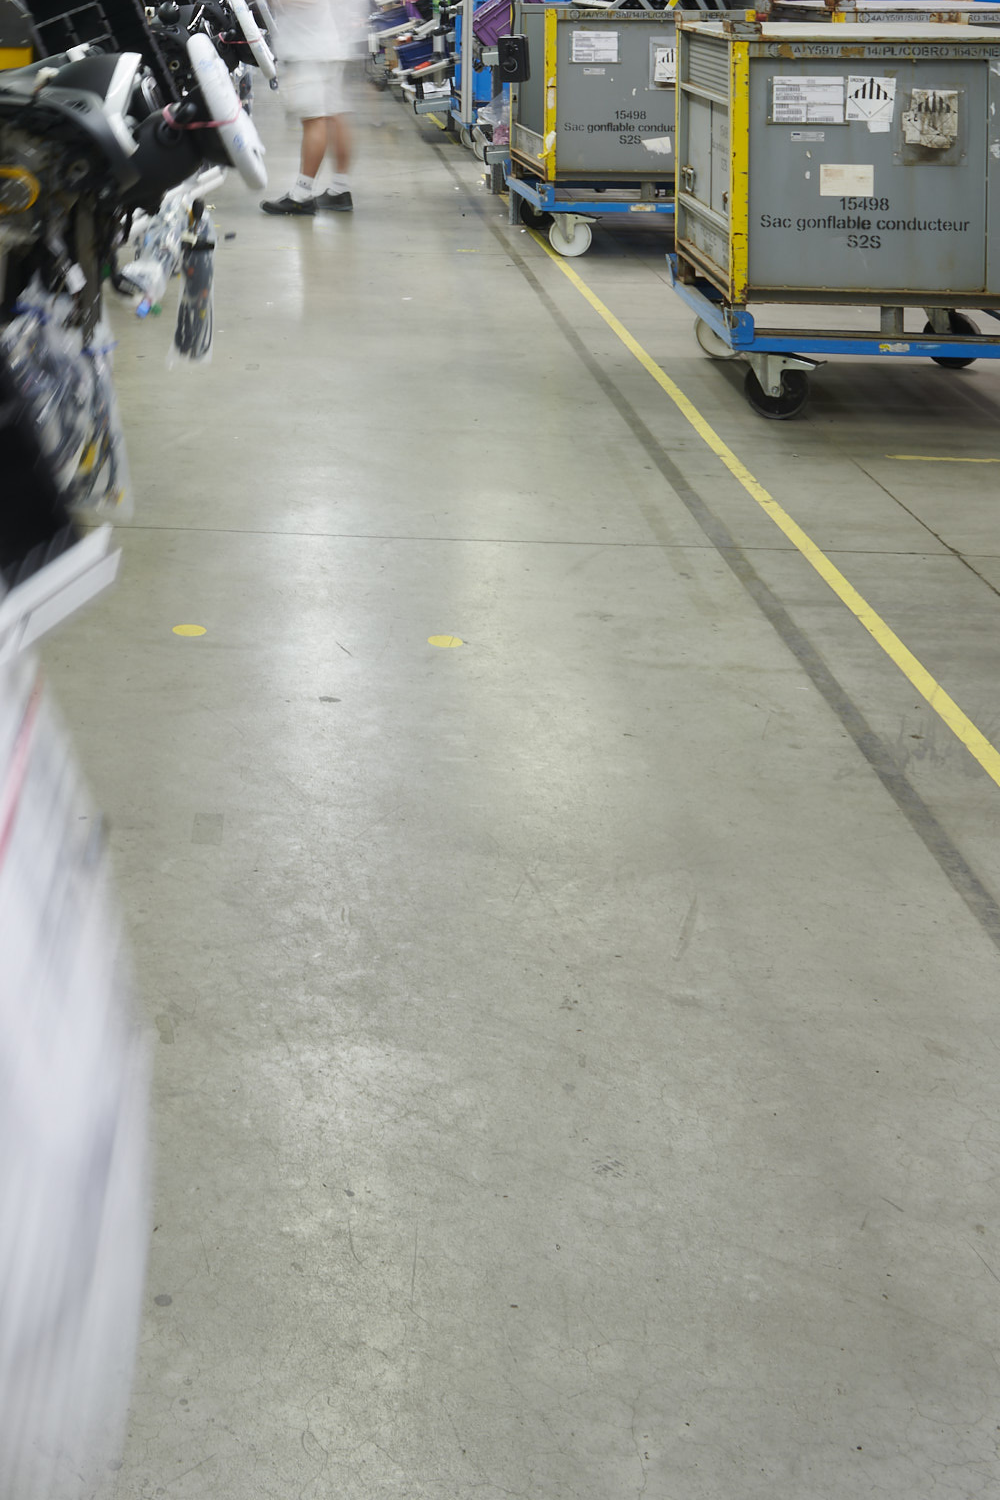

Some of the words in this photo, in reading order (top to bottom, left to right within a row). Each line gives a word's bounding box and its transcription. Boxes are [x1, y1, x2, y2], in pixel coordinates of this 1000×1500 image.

[615, 110, 647, 120] 15498
[564, 122, 585, 131] Sac
[587, 122, 635, 133] gonflable
[619, 135, 641, 145] S2S
[839, 197, 890, 211] 15498
[760, 214, 791, 228] Sac
[796, 215, 871, 231] gonflable
[876, 216, 970, 231] conducteur
[846, 234, 881, 249] S2S
